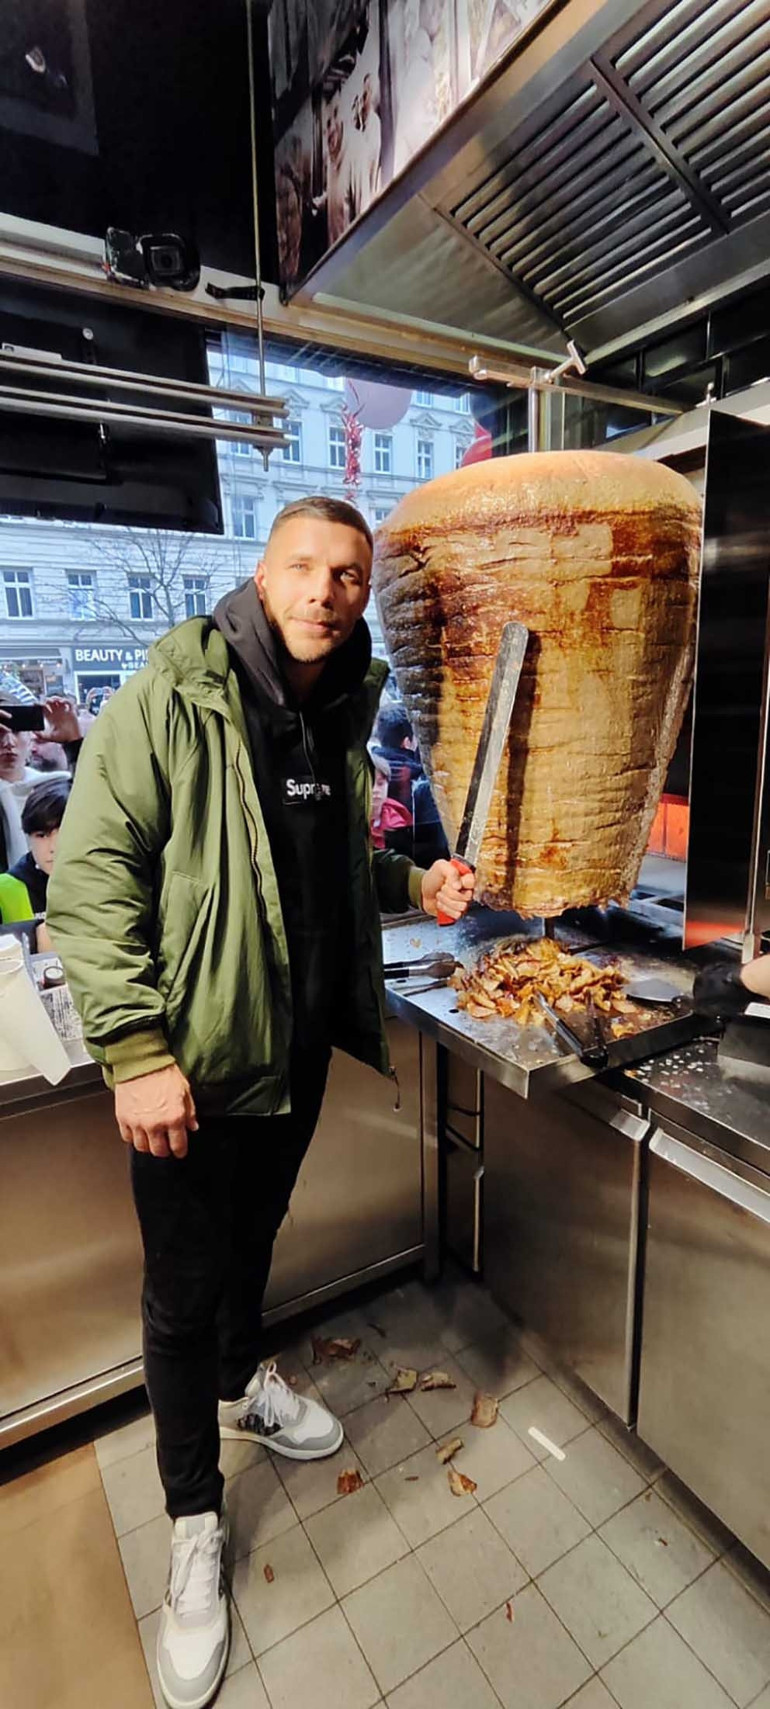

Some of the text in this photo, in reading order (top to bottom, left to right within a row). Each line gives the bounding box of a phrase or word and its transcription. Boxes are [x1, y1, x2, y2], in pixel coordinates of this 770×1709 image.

[75, 649, 122, 662] BEAUTY
[128, 661, 148, 669] BEA
[286, 778, 331, 800] Suprme
